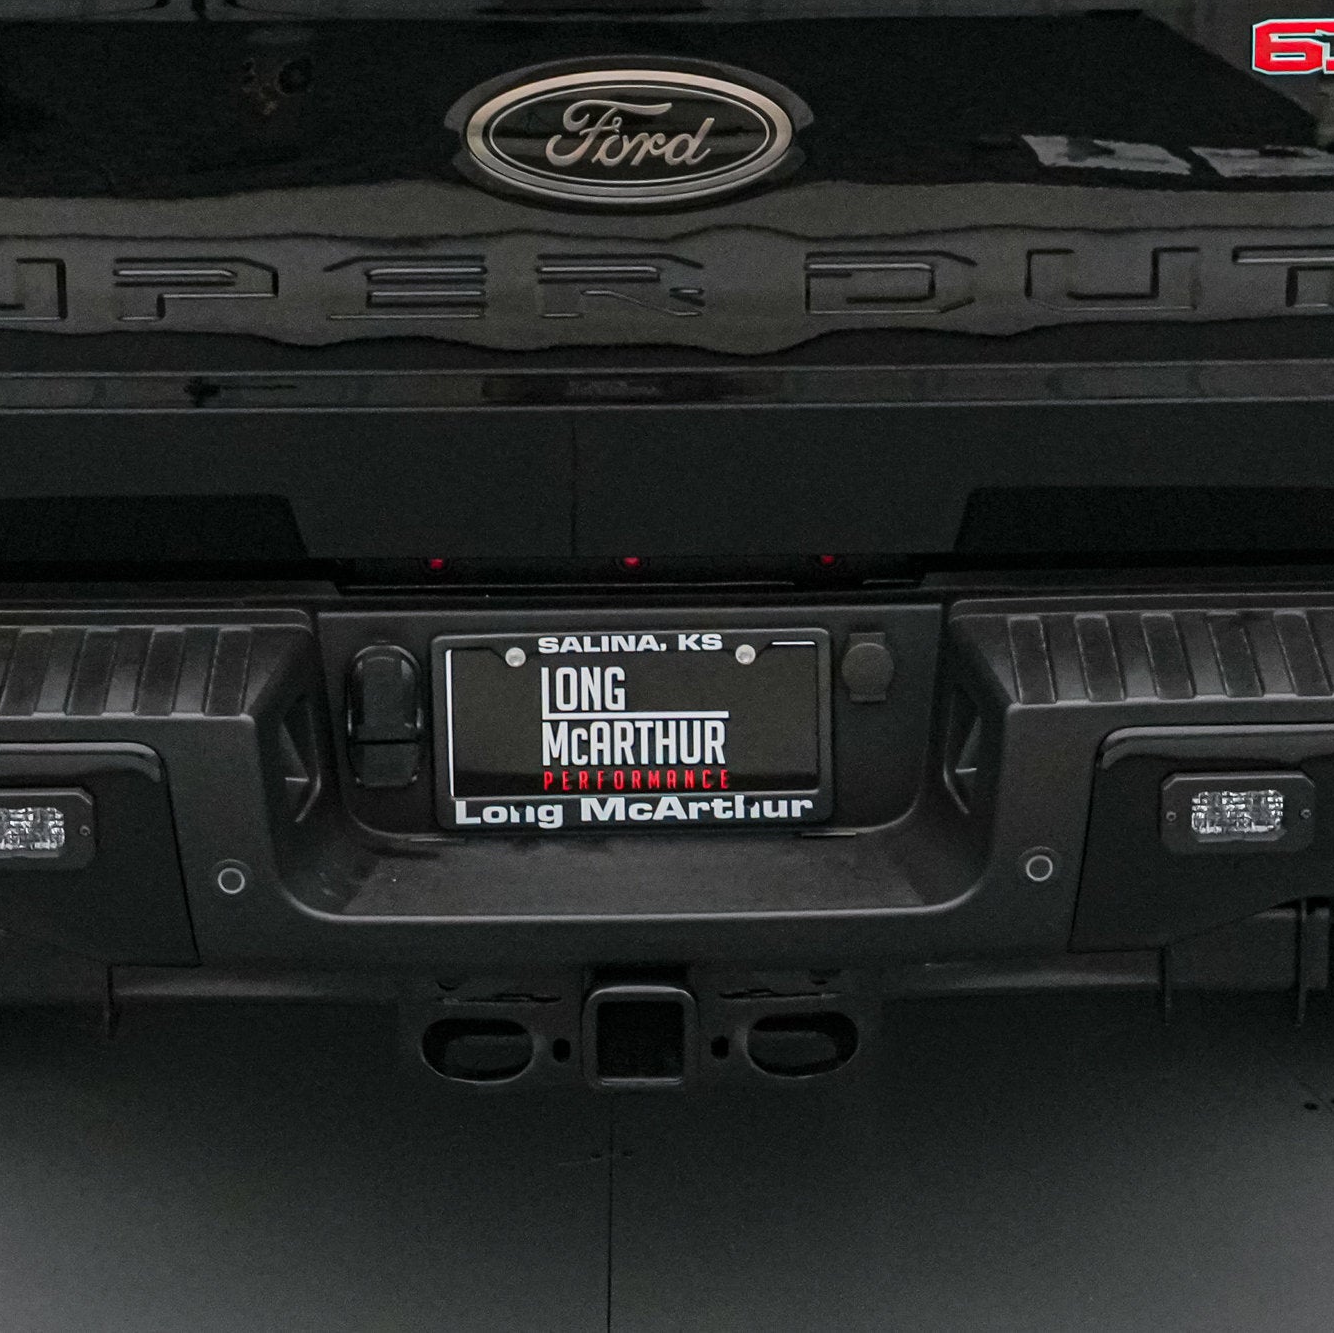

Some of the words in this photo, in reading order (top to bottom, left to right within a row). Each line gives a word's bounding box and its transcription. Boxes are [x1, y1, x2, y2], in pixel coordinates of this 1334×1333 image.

[545, 99, 716, 167] Ford
[537, 636, 667, 654] SALINA,
[677, 634, 723, 651] KS
[541, 666, 626, 720] LONG
[542, 721, 726, 767] McARTHUR
[543, 769, 730, 791] PERFORMANCE
[454, 800, 563, 829] Long
[580, 795, 813, 822] McArthur
